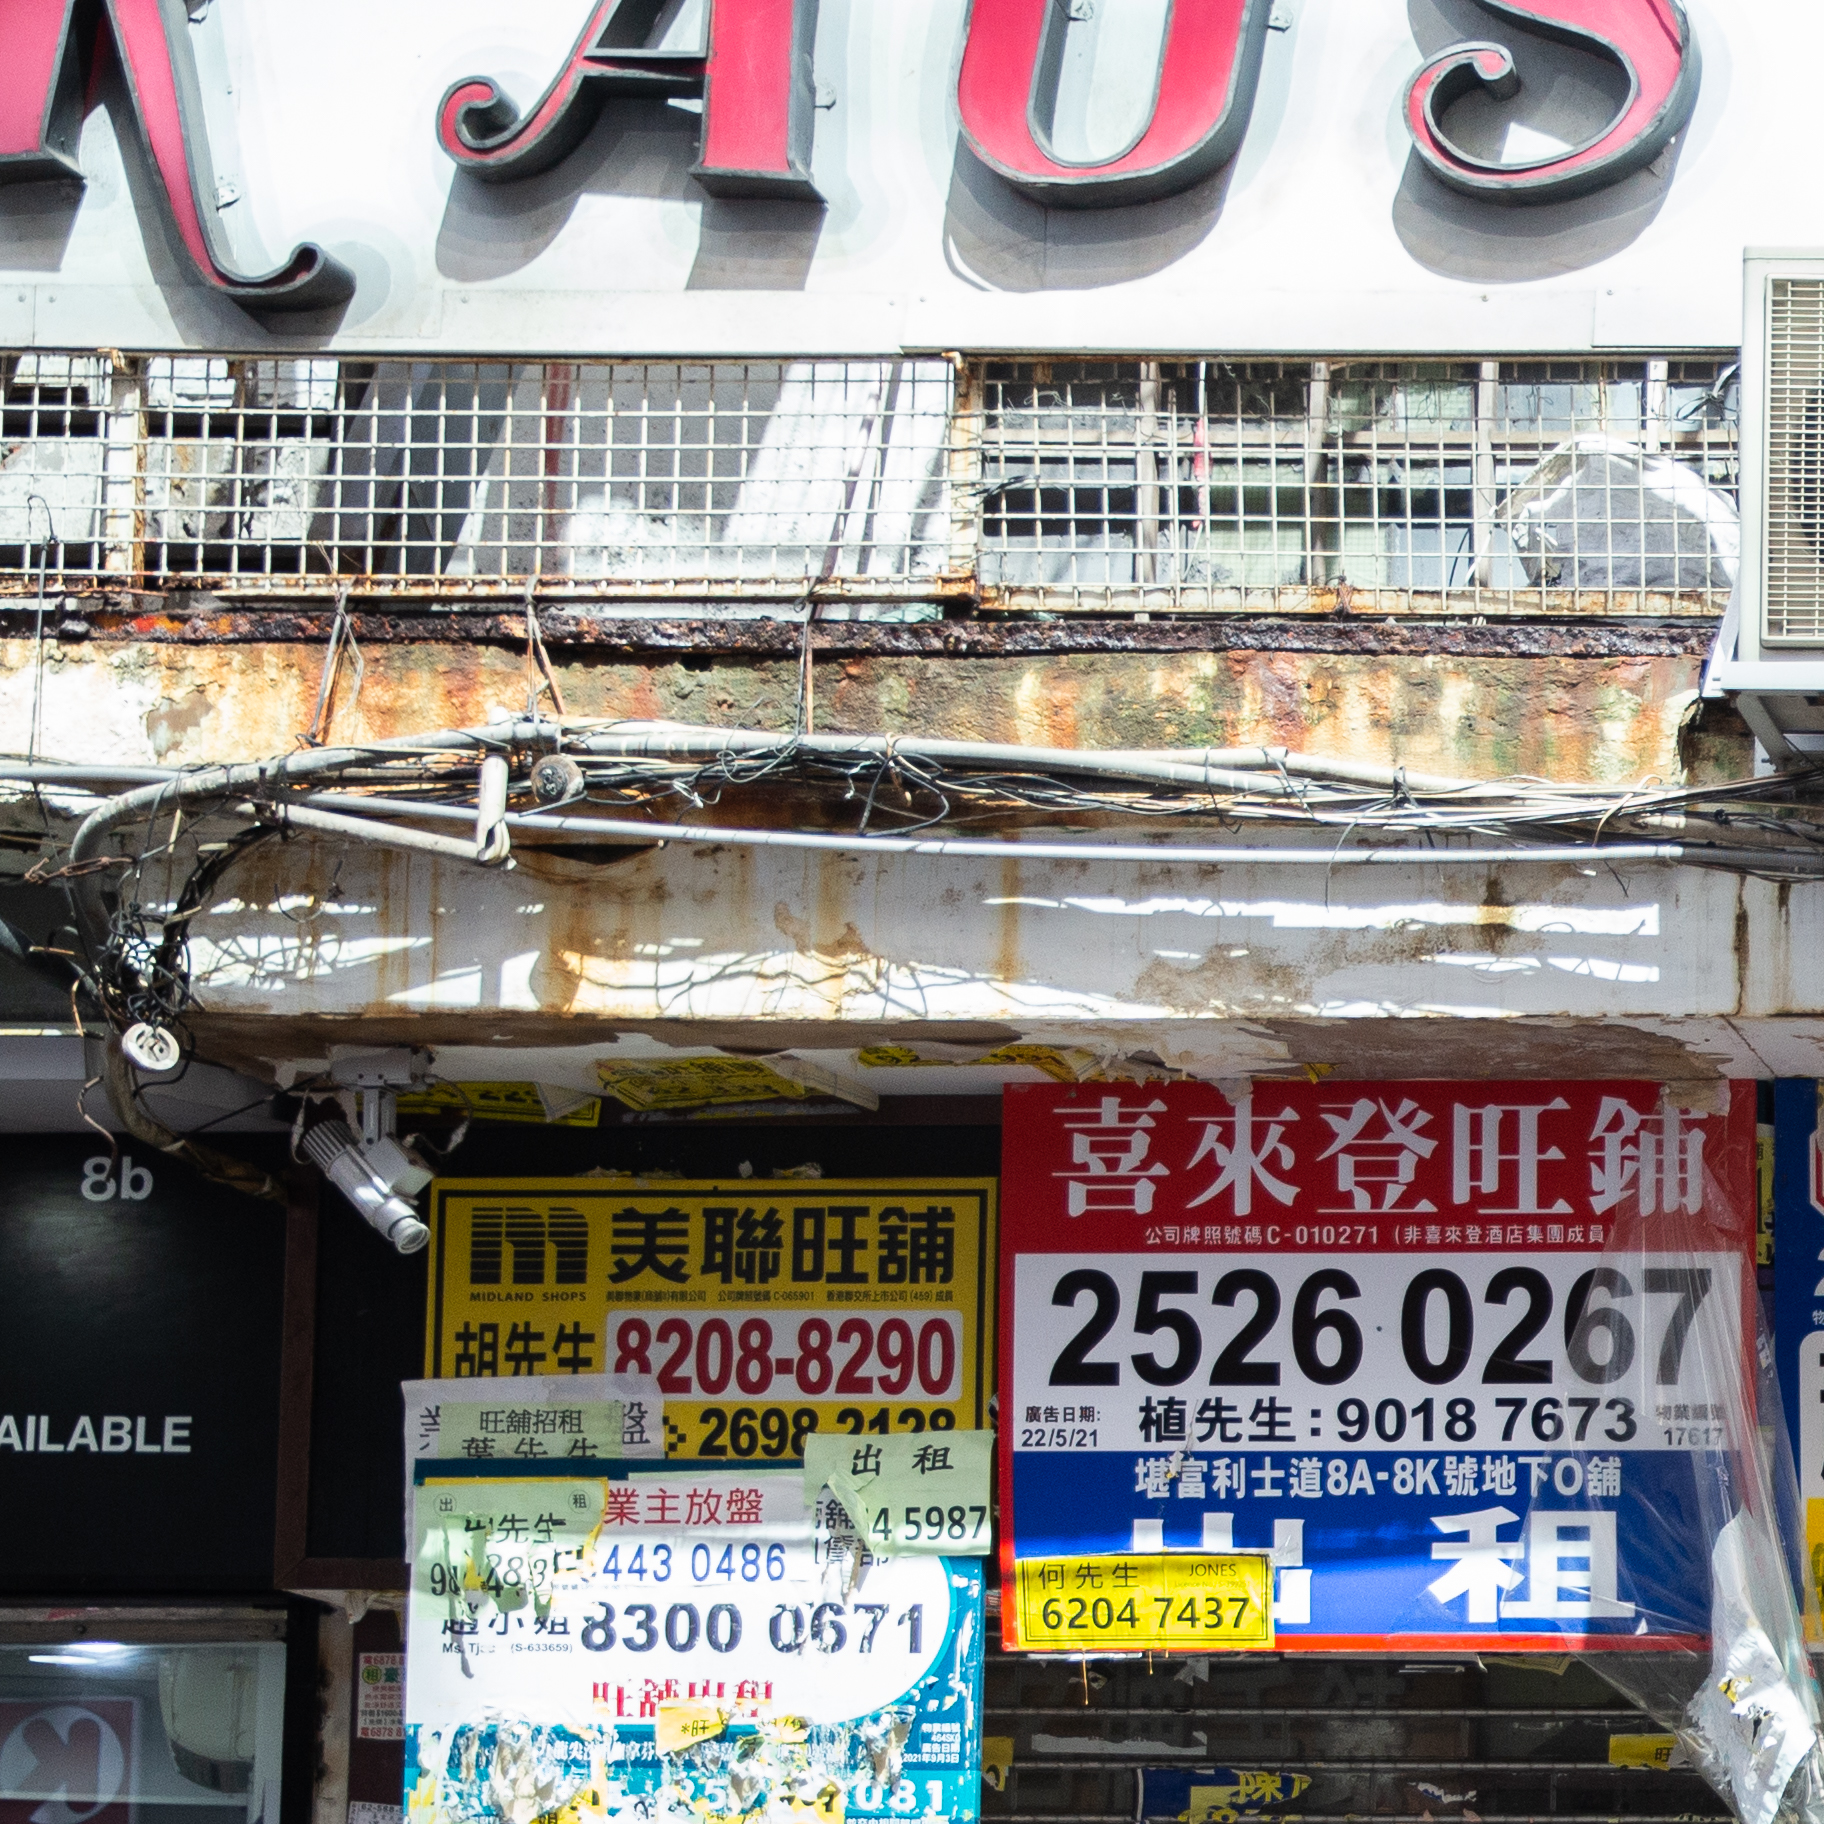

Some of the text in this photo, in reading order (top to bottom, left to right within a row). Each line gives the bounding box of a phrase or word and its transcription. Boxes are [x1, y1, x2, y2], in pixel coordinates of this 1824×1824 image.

[1052, 1095, 1709, 1218] 喜來登旺鋪
[80, 1156, 153, 1201] 8b
[607, 1205, 955, 1285] 美聯旺舖
[469, 1292, 588, 1302] MIDLAND SHOPS
[1047, 1265, 1714, 1388] 2526 0267
[615, 1317, 955, 1395] 8208-8290
[480, 1409, 583, 1434] 旺舖招租
[700, 1407, 819, 1458] 2698
[1021, 1427, 1100, 1449] 22/5/21
[1337, 1398, 1477, 1444] 9018
[1501, 1397, 1638, 1444] 7673
[851, 1443, 954, 1476] 出租
[604, 1487, 764, 1526] 業主放盤
[905, 1505, 987, 1541] 5987
[692, 1543, 787, 1582] 0486
[1038, 1561, 1238, 1590] 何先生 JONES
[581, 1602, 742, 1653] 8300
[769, 1602, 923, 1654] 0671
[1042, 1597, 1250, 1629] 6204 7437
